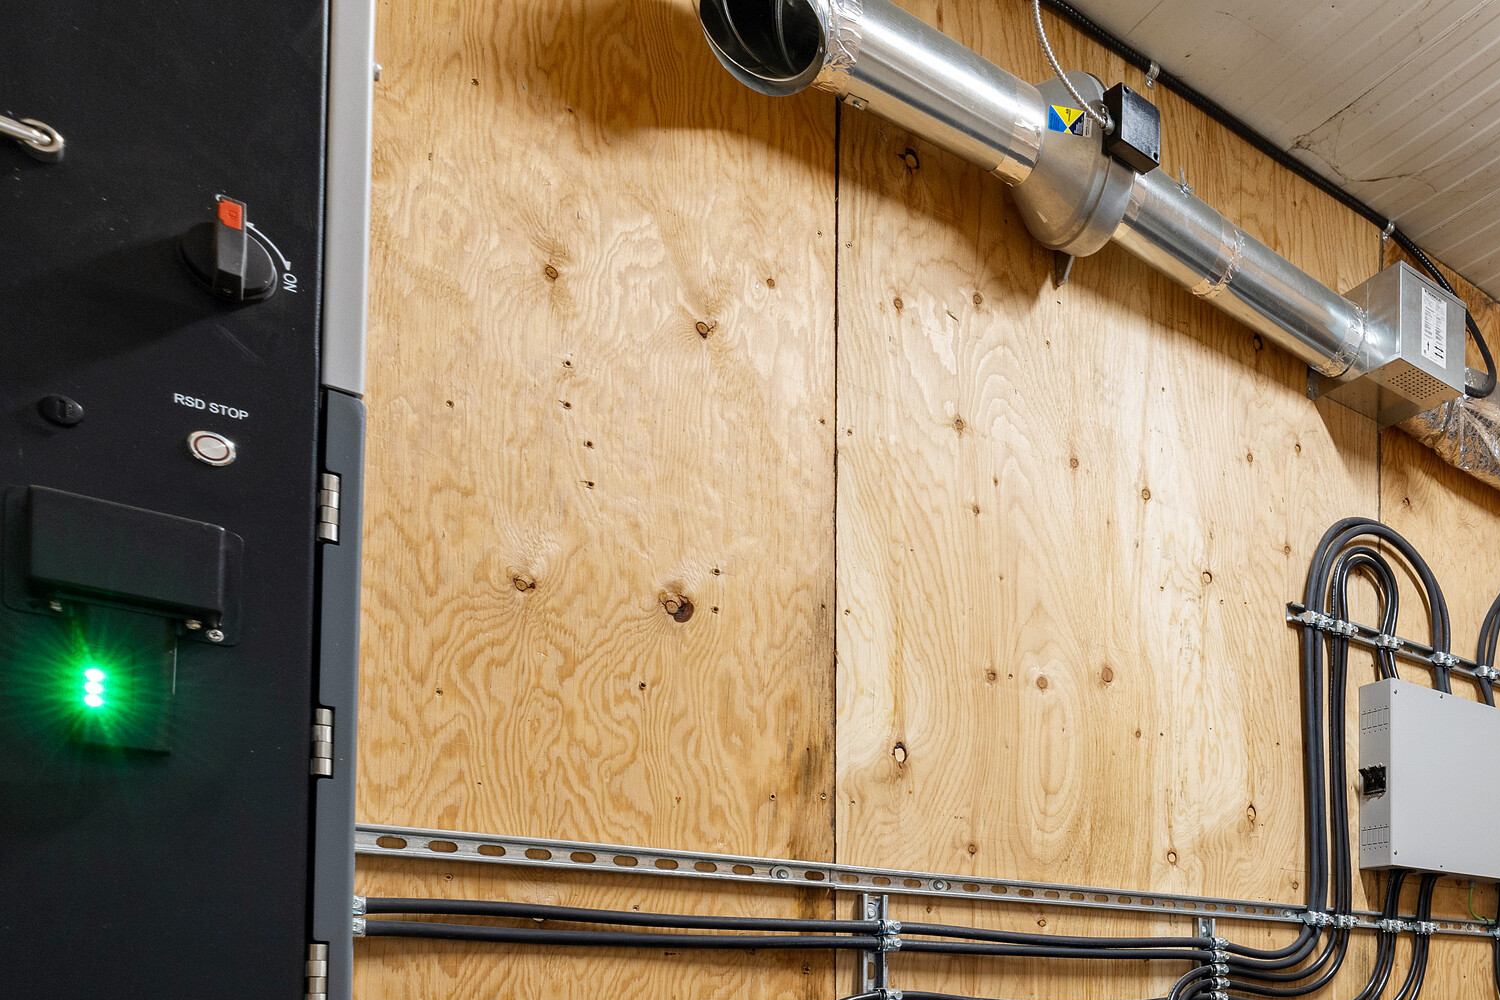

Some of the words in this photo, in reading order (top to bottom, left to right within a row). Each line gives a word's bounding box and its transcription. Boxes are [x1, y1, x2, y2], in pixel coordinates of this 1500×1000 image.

[283, 273, 298, 293] ON
[173, 393, 206, 410] RSD
[208, 402, 249, 420] STOP
